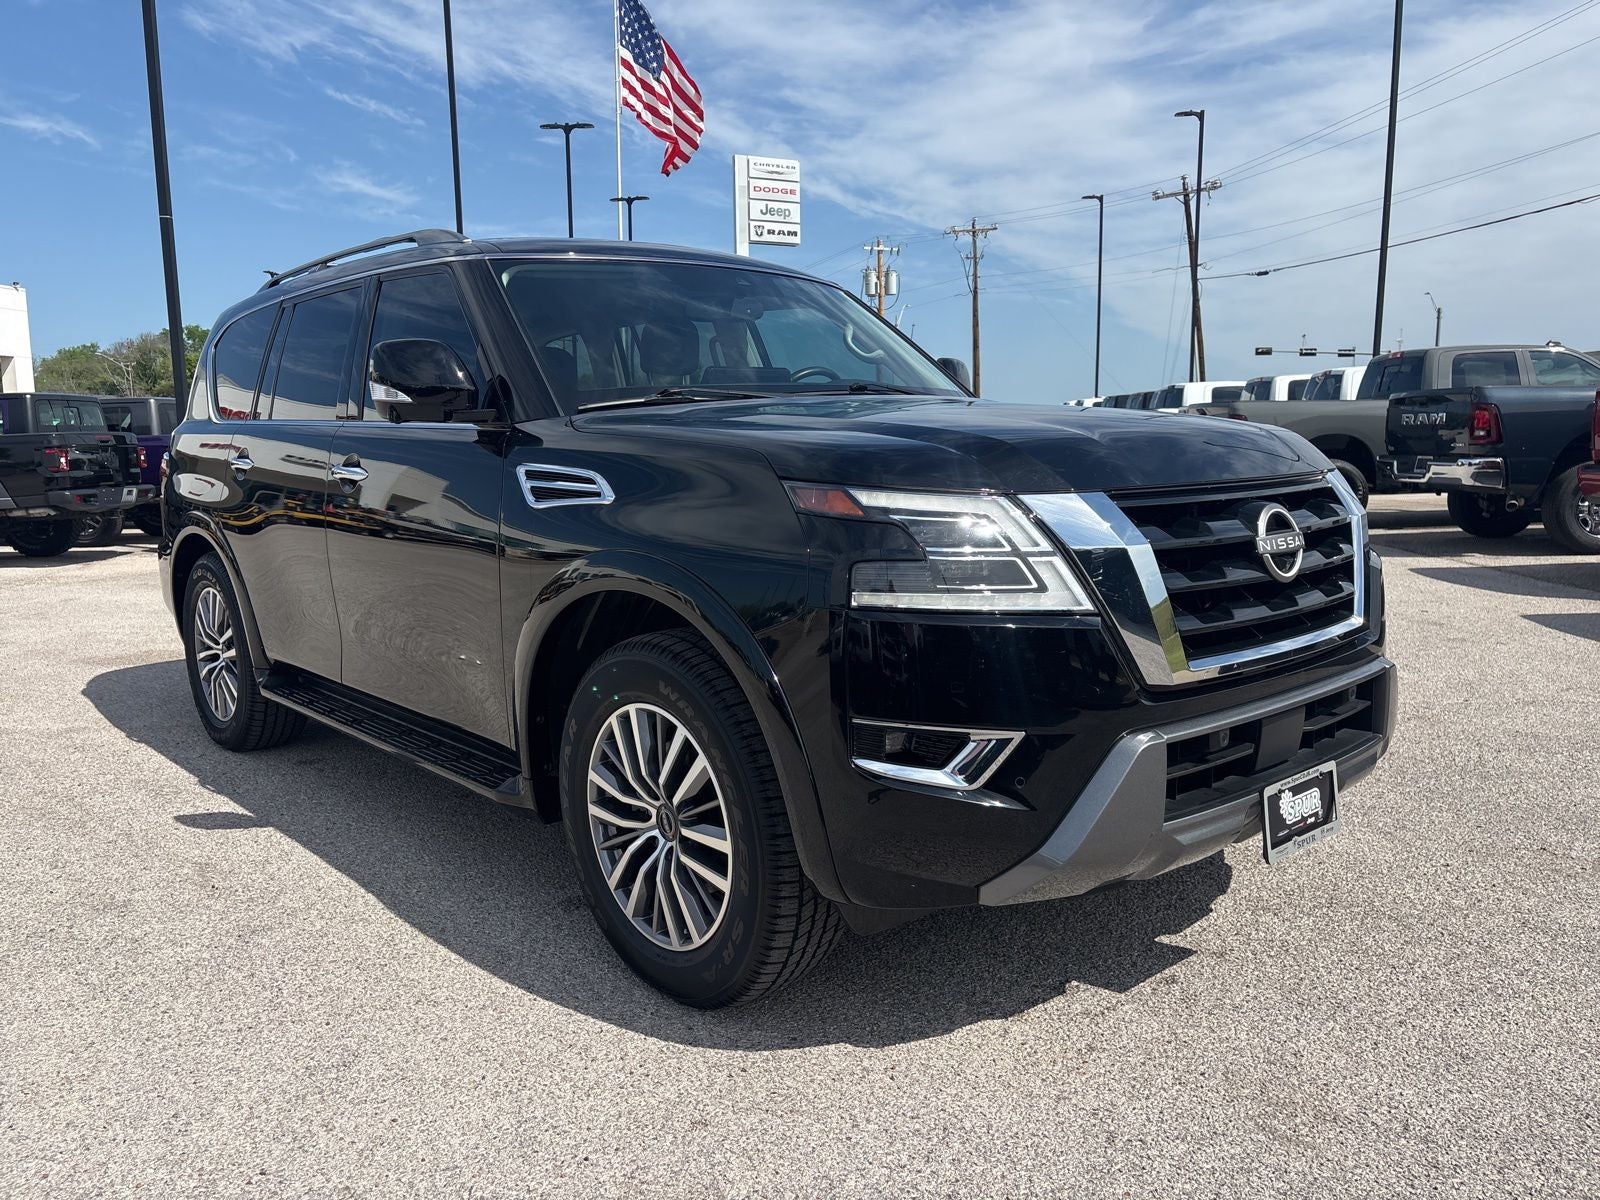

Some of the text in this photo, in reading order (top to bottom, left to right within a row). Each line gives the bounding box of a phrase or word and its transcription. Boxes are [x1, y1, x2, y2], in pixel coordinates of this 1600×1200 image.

[753, 162, 796, 170] CHRYSLER
[753, 186, 797, 195] DODGE
[760, 203, 791, 219] Jeep
[767, 228, 798, 237] RAM
[1401, 412, 1446, 425] RAM
[1259, 534, 1305, 552] NISSAN
[657, 679, 750, 897] WRANGLER
[1287, 791, 1320, 821] SPUR
[1296, 834, 1316, 849] SPUR
